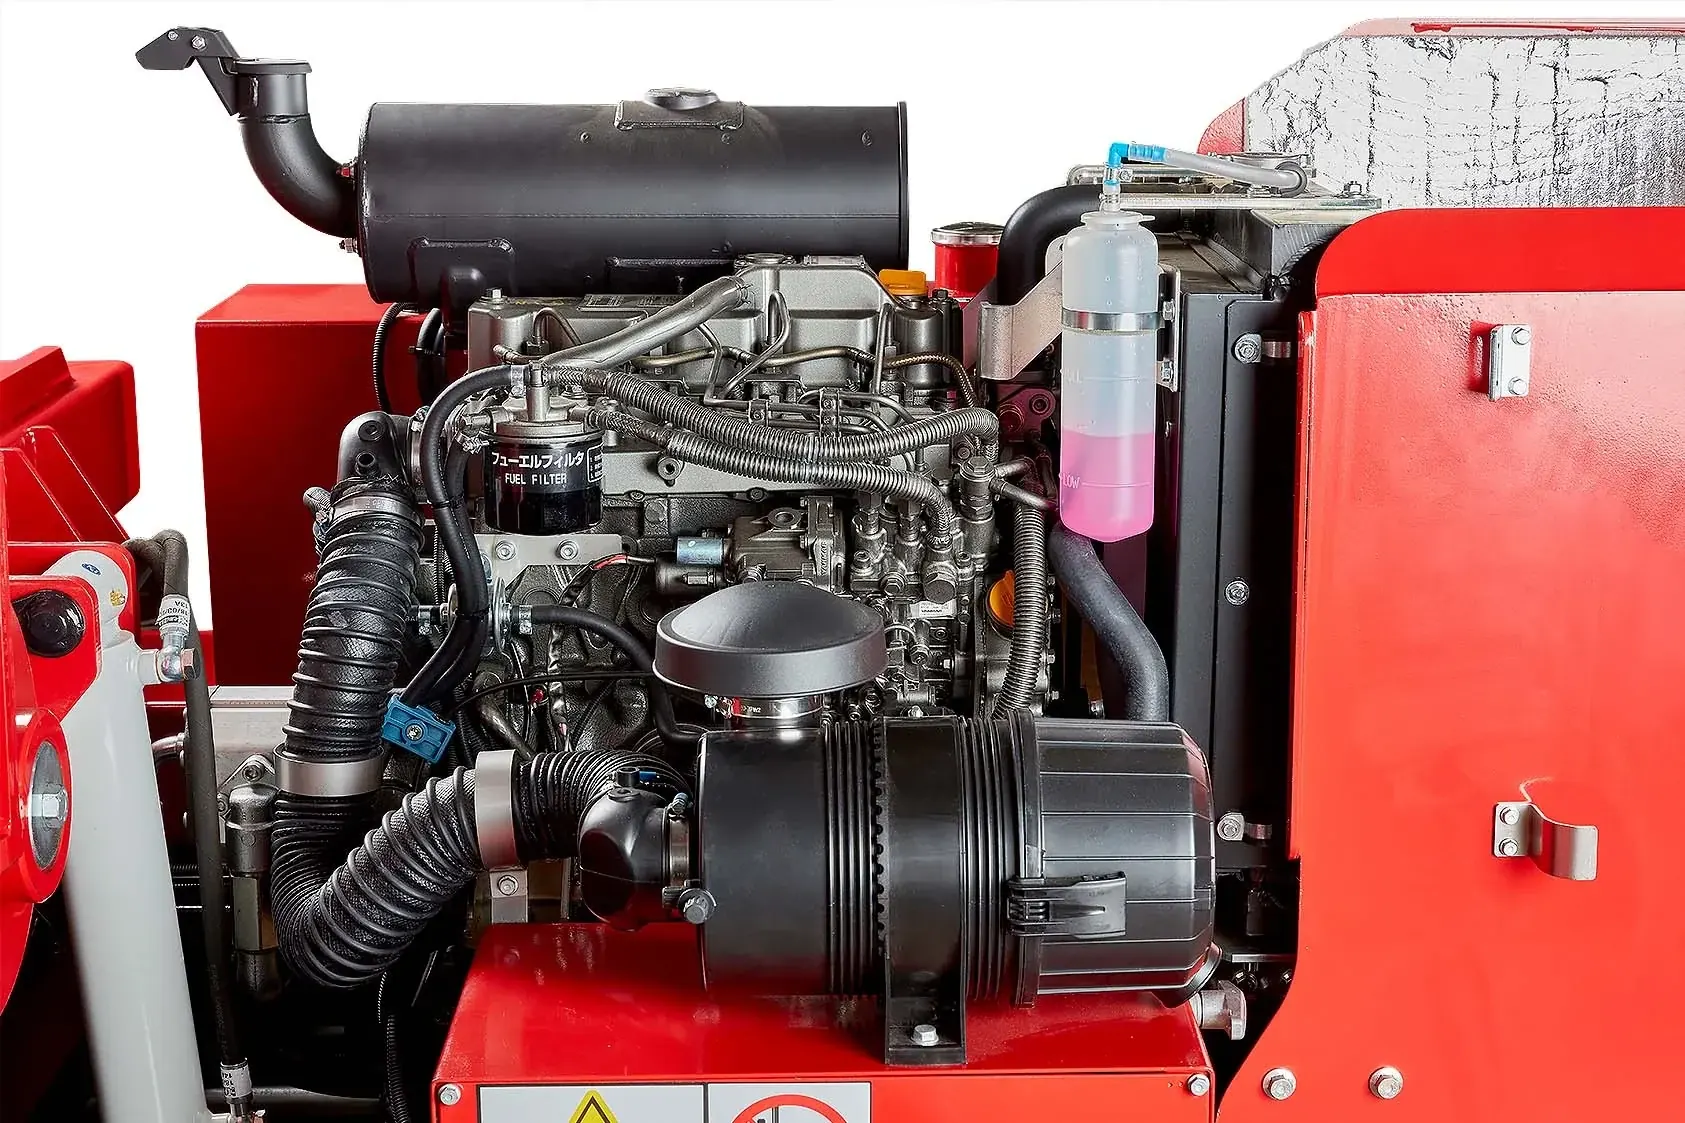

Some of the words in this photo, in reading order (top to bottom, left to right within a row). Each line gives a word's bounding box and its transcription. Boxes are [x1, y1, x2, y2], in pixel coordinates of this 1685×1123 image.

[491, 451, 585, 469] フューエルフィルタ
[505, 473, 527, 485] FUEL
[532, 473, 567, 485] FILTER
